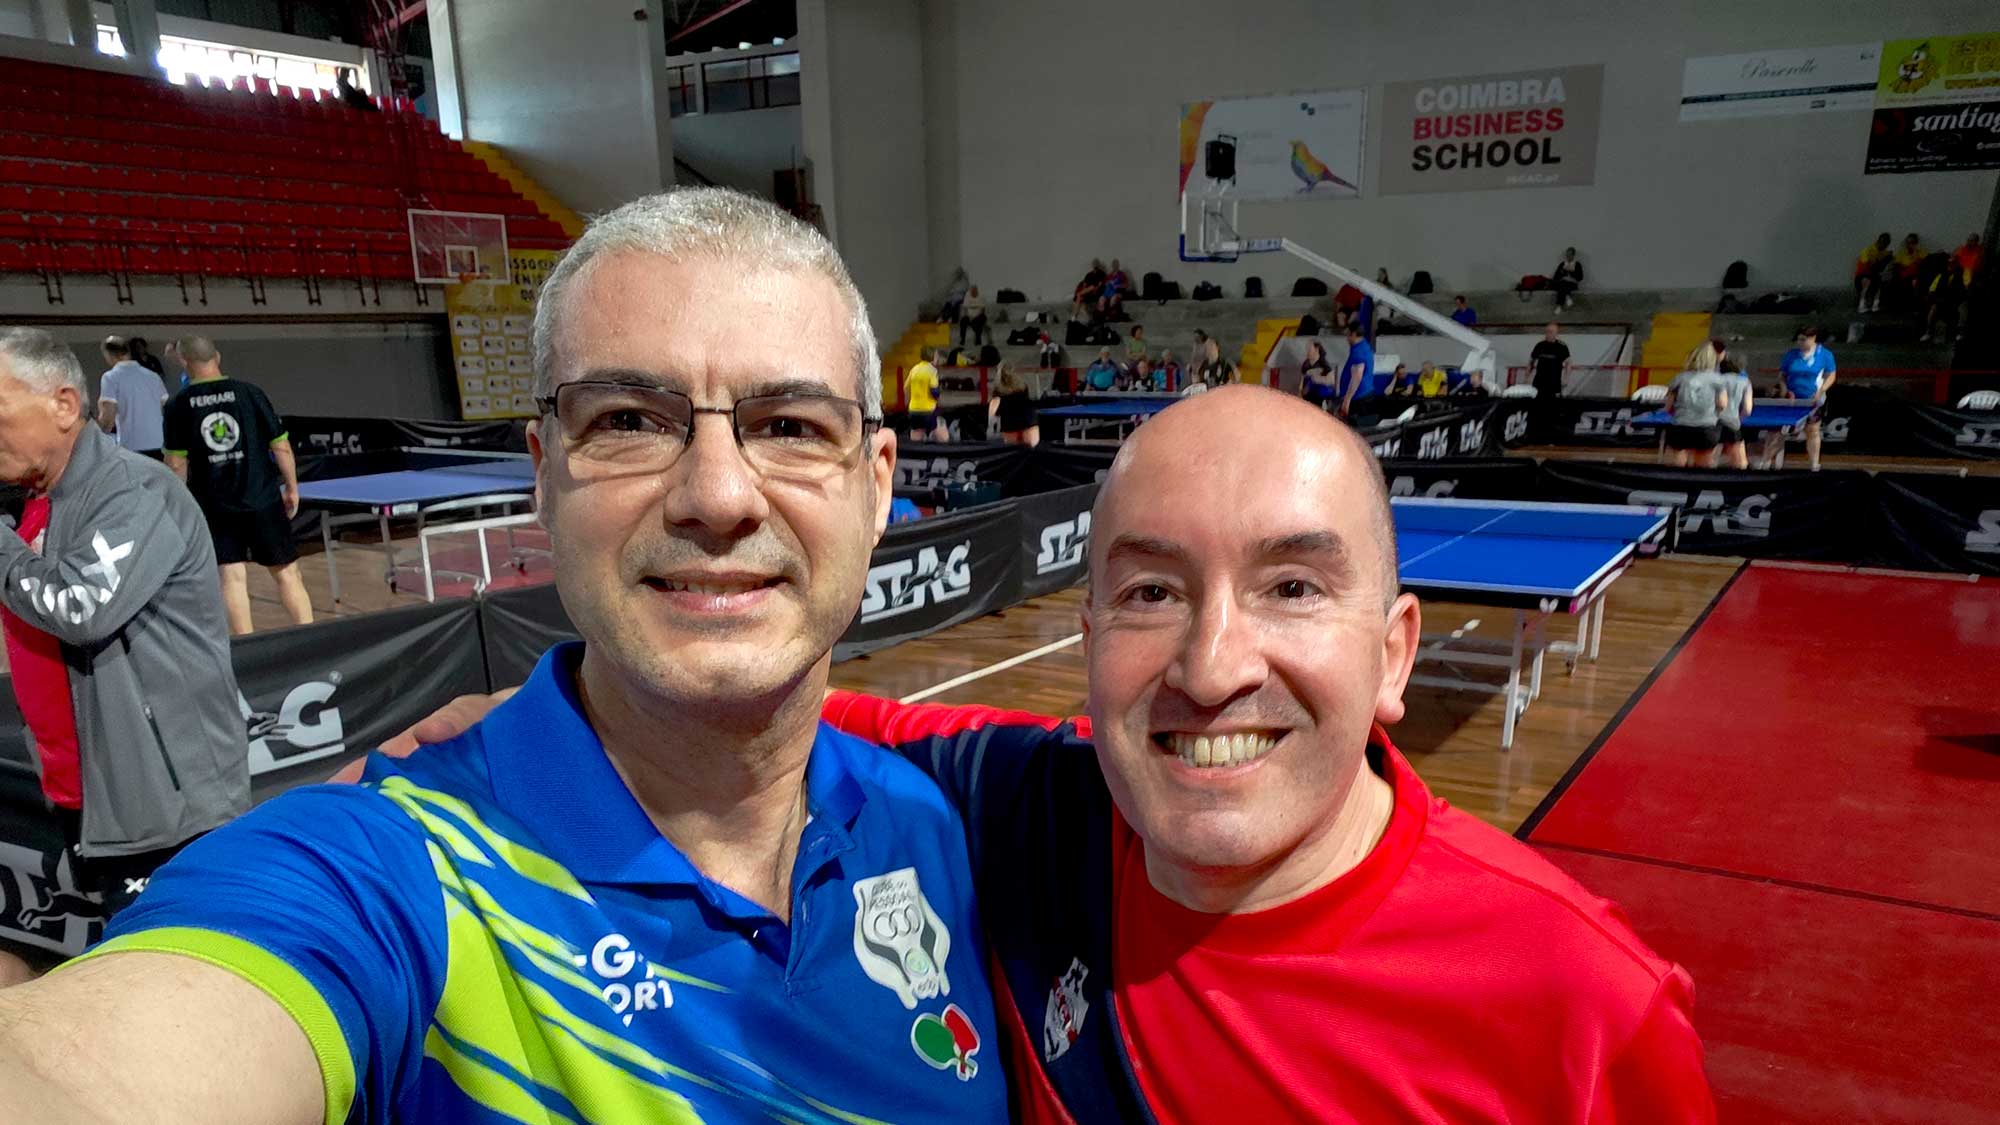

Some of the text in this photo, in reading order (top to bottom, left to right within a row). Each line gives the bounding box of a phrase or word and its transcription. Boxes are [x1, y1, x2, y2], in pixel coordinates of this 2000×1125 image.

[1415, 77, 1566, 113] COIMBRA
[1413, 108, 1565, 140] BUSINESS
[1411, 138, 1562, 172] SCHOOL
[861, 545, 972, 624] STAG
